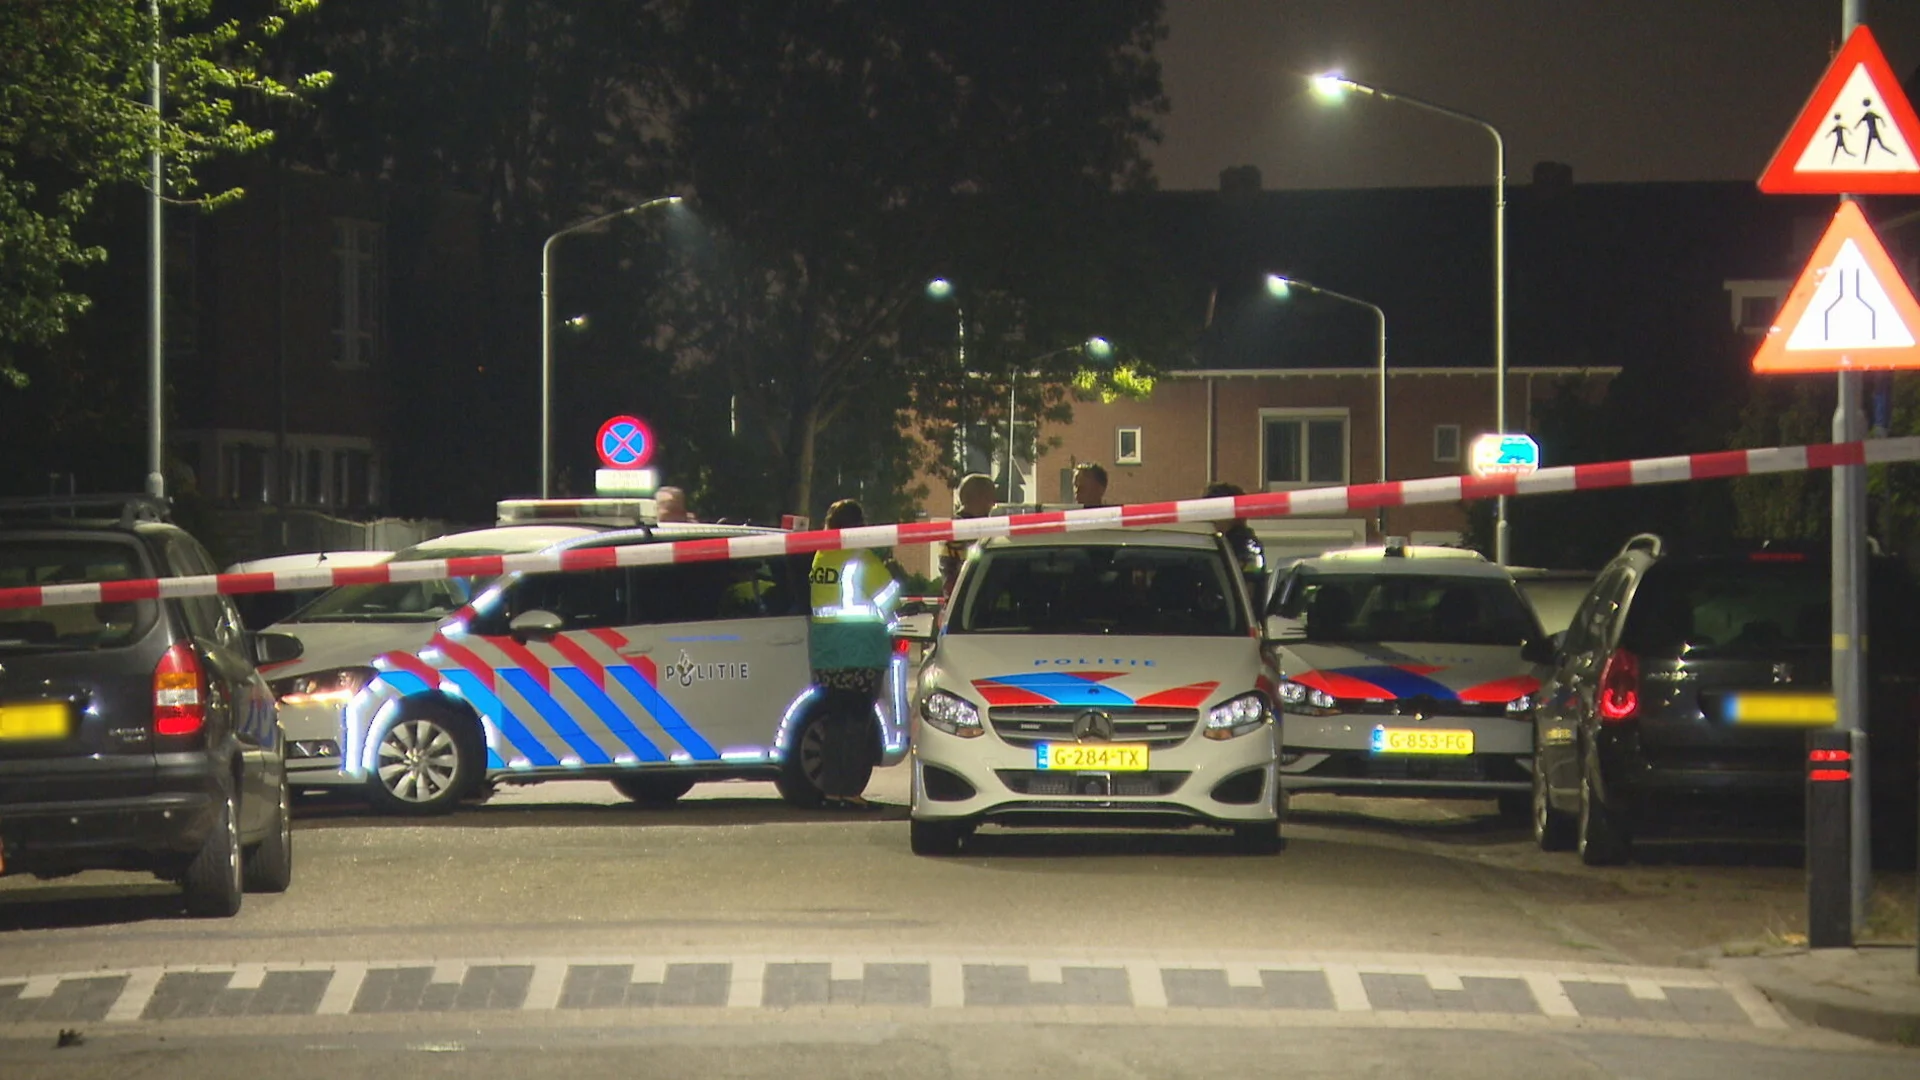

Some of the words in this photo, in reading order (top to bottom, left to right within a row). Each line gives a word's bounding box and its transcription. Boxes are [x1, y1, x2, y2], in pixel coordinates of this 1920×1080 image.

[1033, 657, 1155, 667] POLITIE
[664, 661, 748, 687] POLITIE
[1390, 733, 1467, 750] G-853-FG
[1054, 748, 1138, 766] G-284-TX
